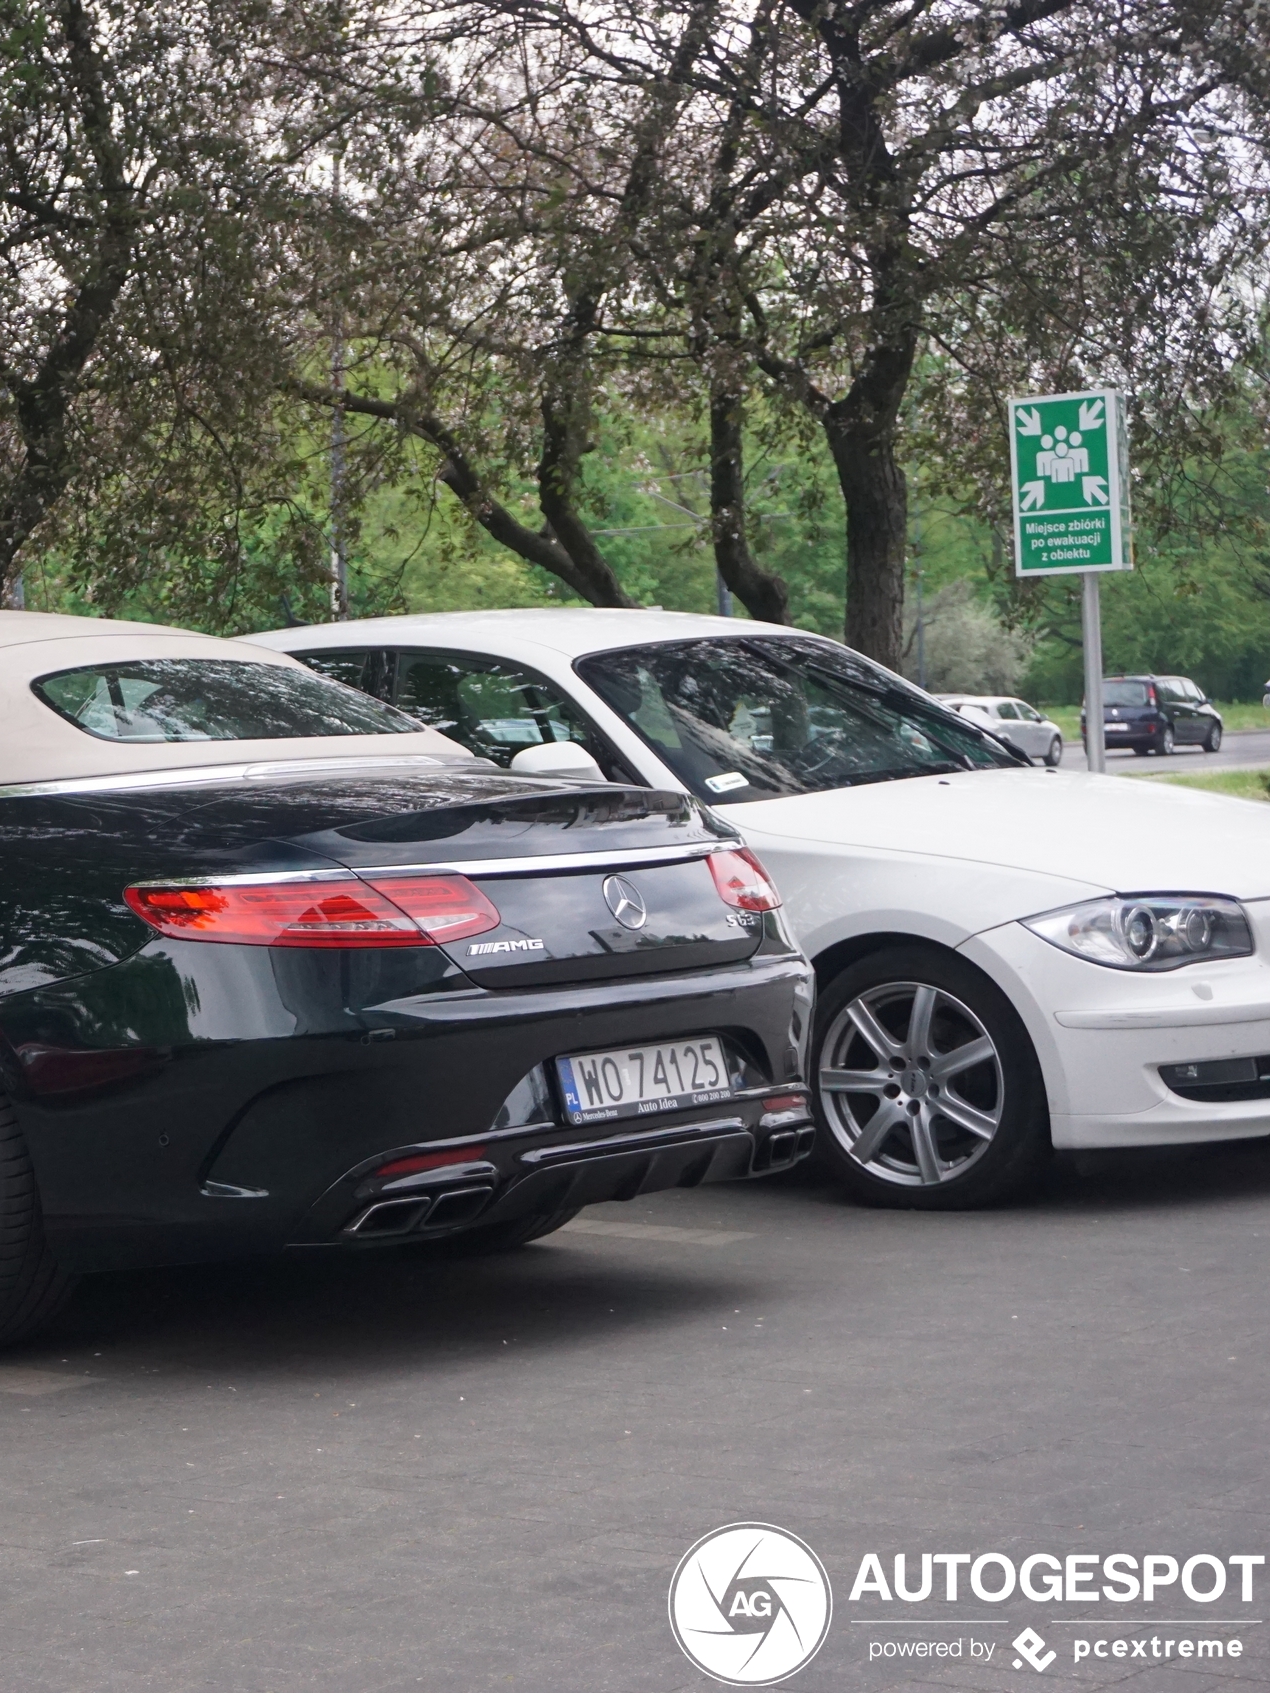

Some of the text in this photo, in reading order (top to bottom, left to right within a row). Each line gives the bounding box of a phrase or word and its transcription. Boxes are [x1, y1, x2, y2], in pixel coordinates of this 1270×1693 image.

[1026, 518, 1105, 535] Miejsce zbiórki
[1031, 532, 1101, 550] po ewakuacji
[1041, 548, 1091, 561] z obiektu
[492, 939, 544, 953] AMG
[578, 1043, 720, 1106] WO 74125
[565, 1093, 579, 1106] PL
[637, 1098, 679, 1114] Auto Idea
[582, 1109, 618, 1121] Mercedes-Benz
